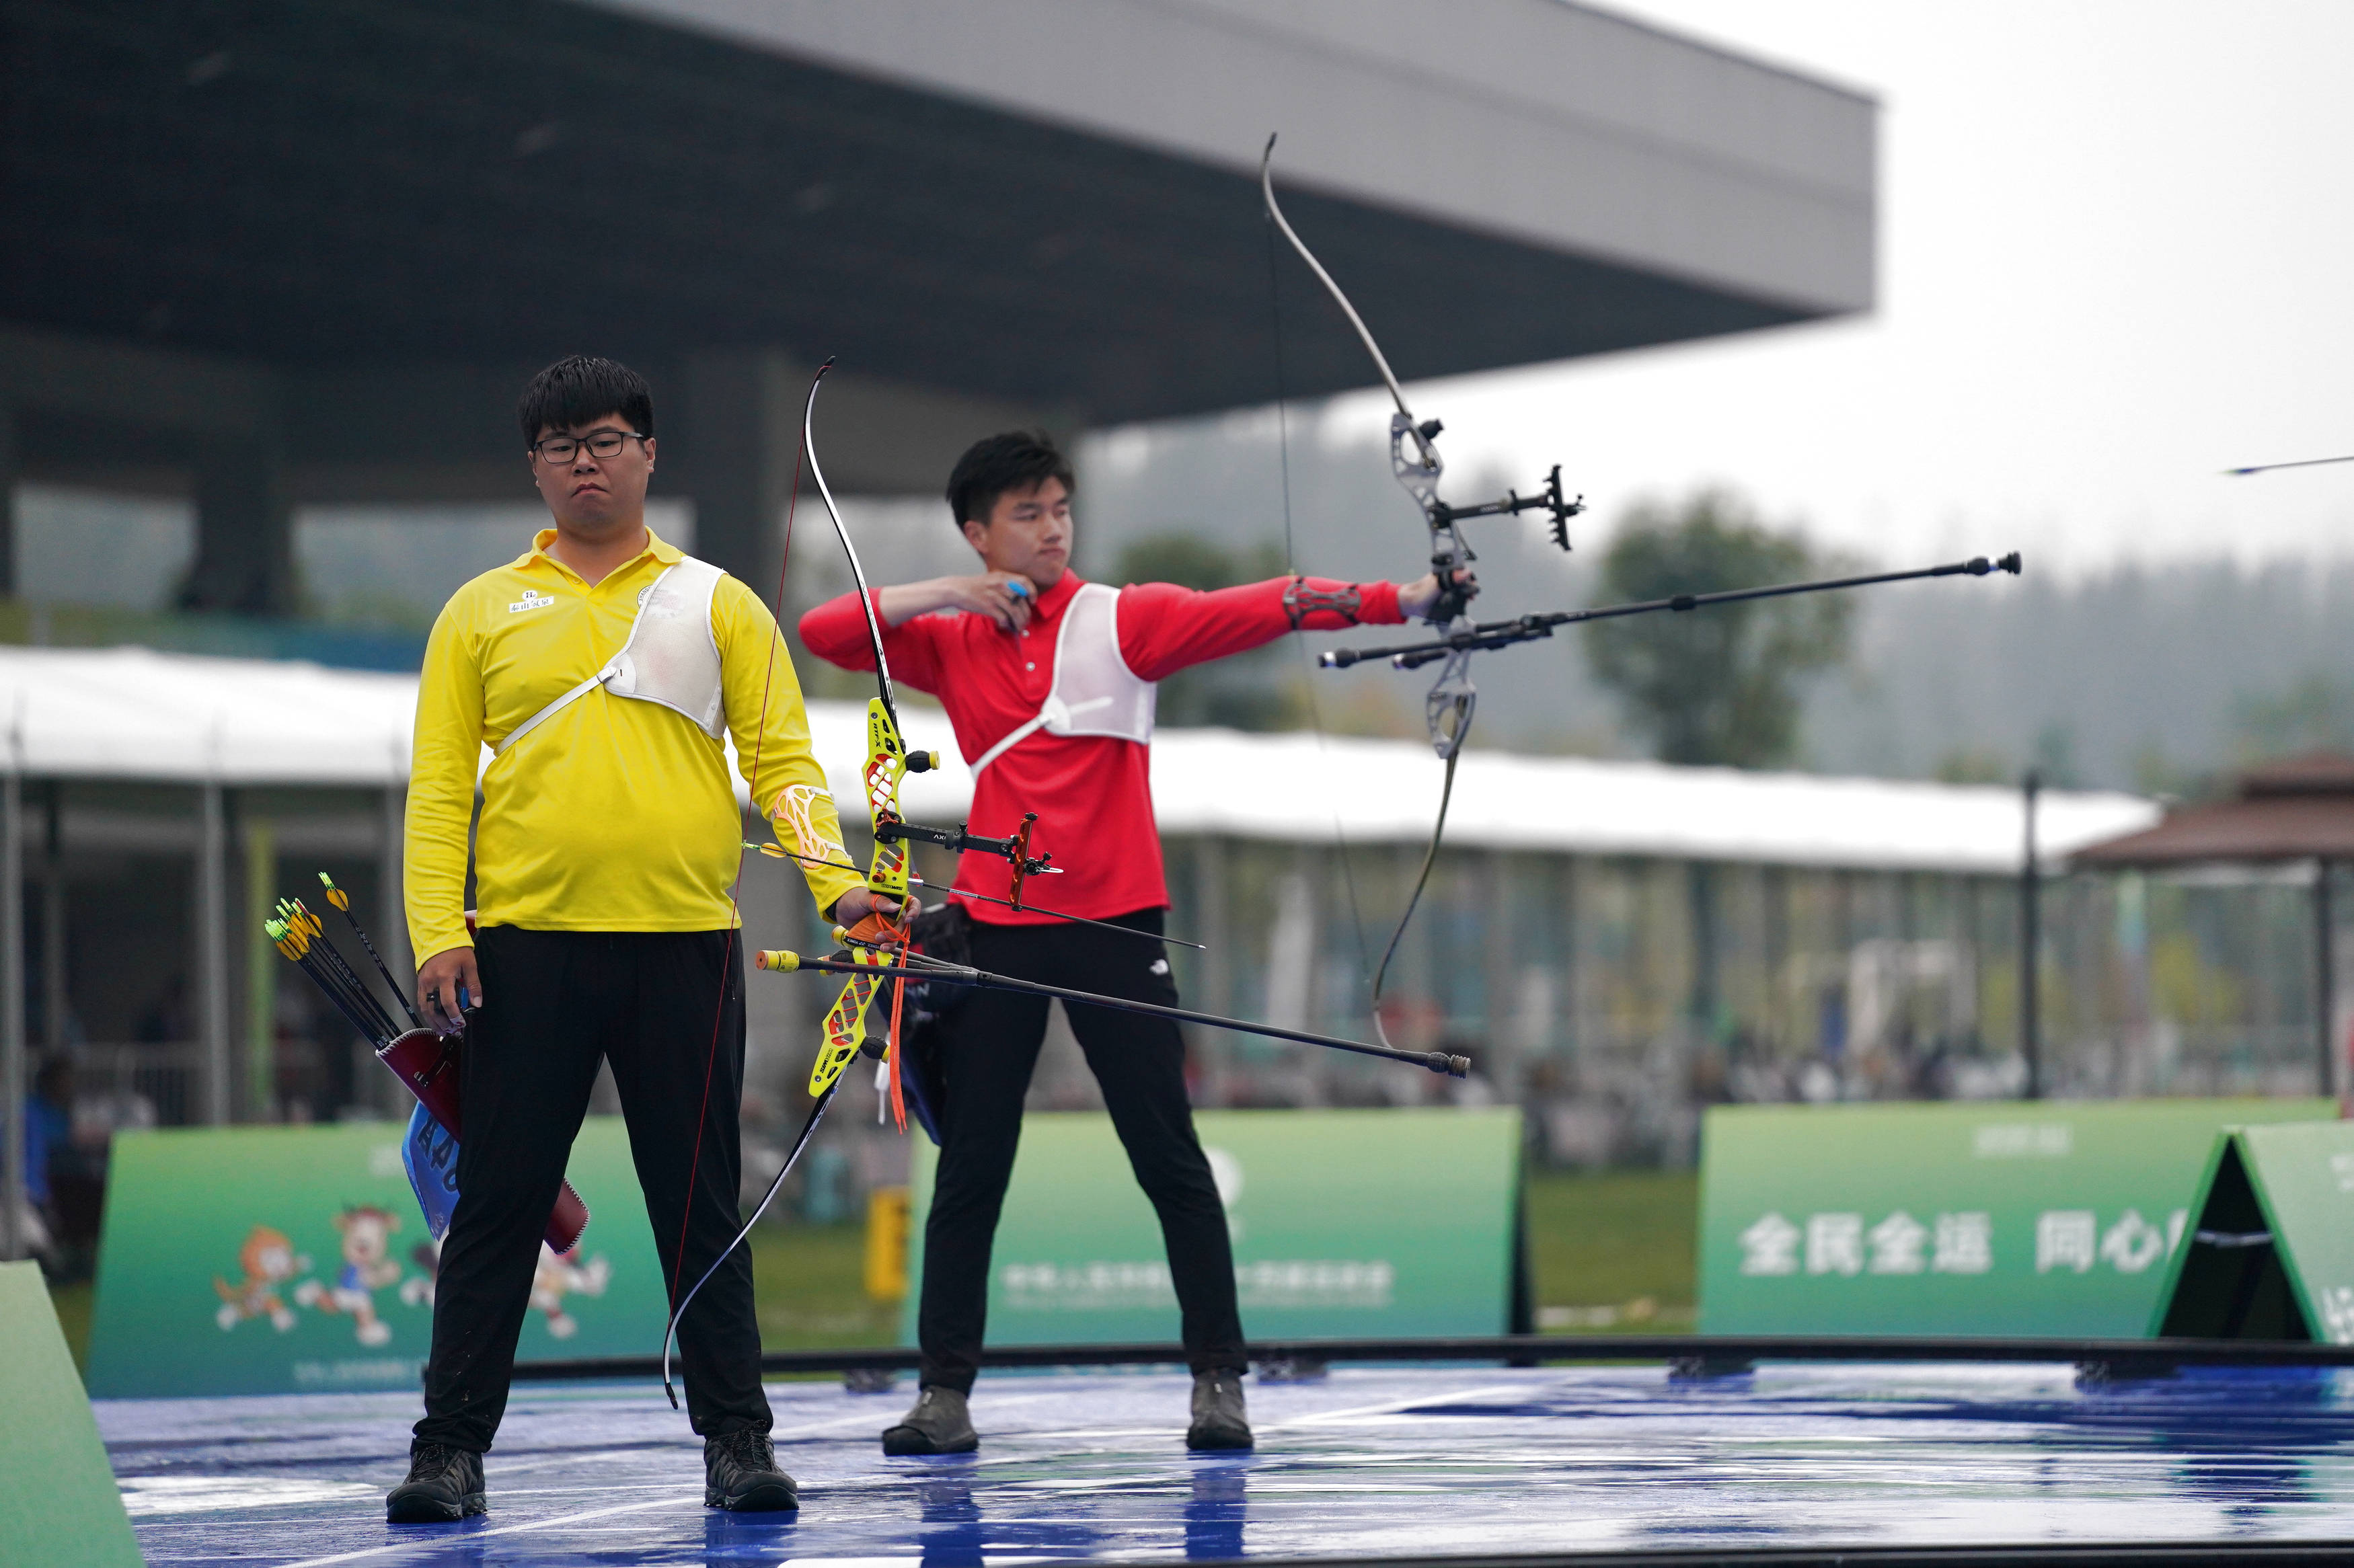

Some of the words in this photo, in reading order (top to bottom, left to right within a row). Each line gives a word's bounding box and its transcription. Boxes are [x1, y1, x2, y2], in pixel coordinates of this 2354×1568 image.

[1740, 1212, 1993, 1276] 全民全运
[2035, 1210, 2189, 1274] 同心
